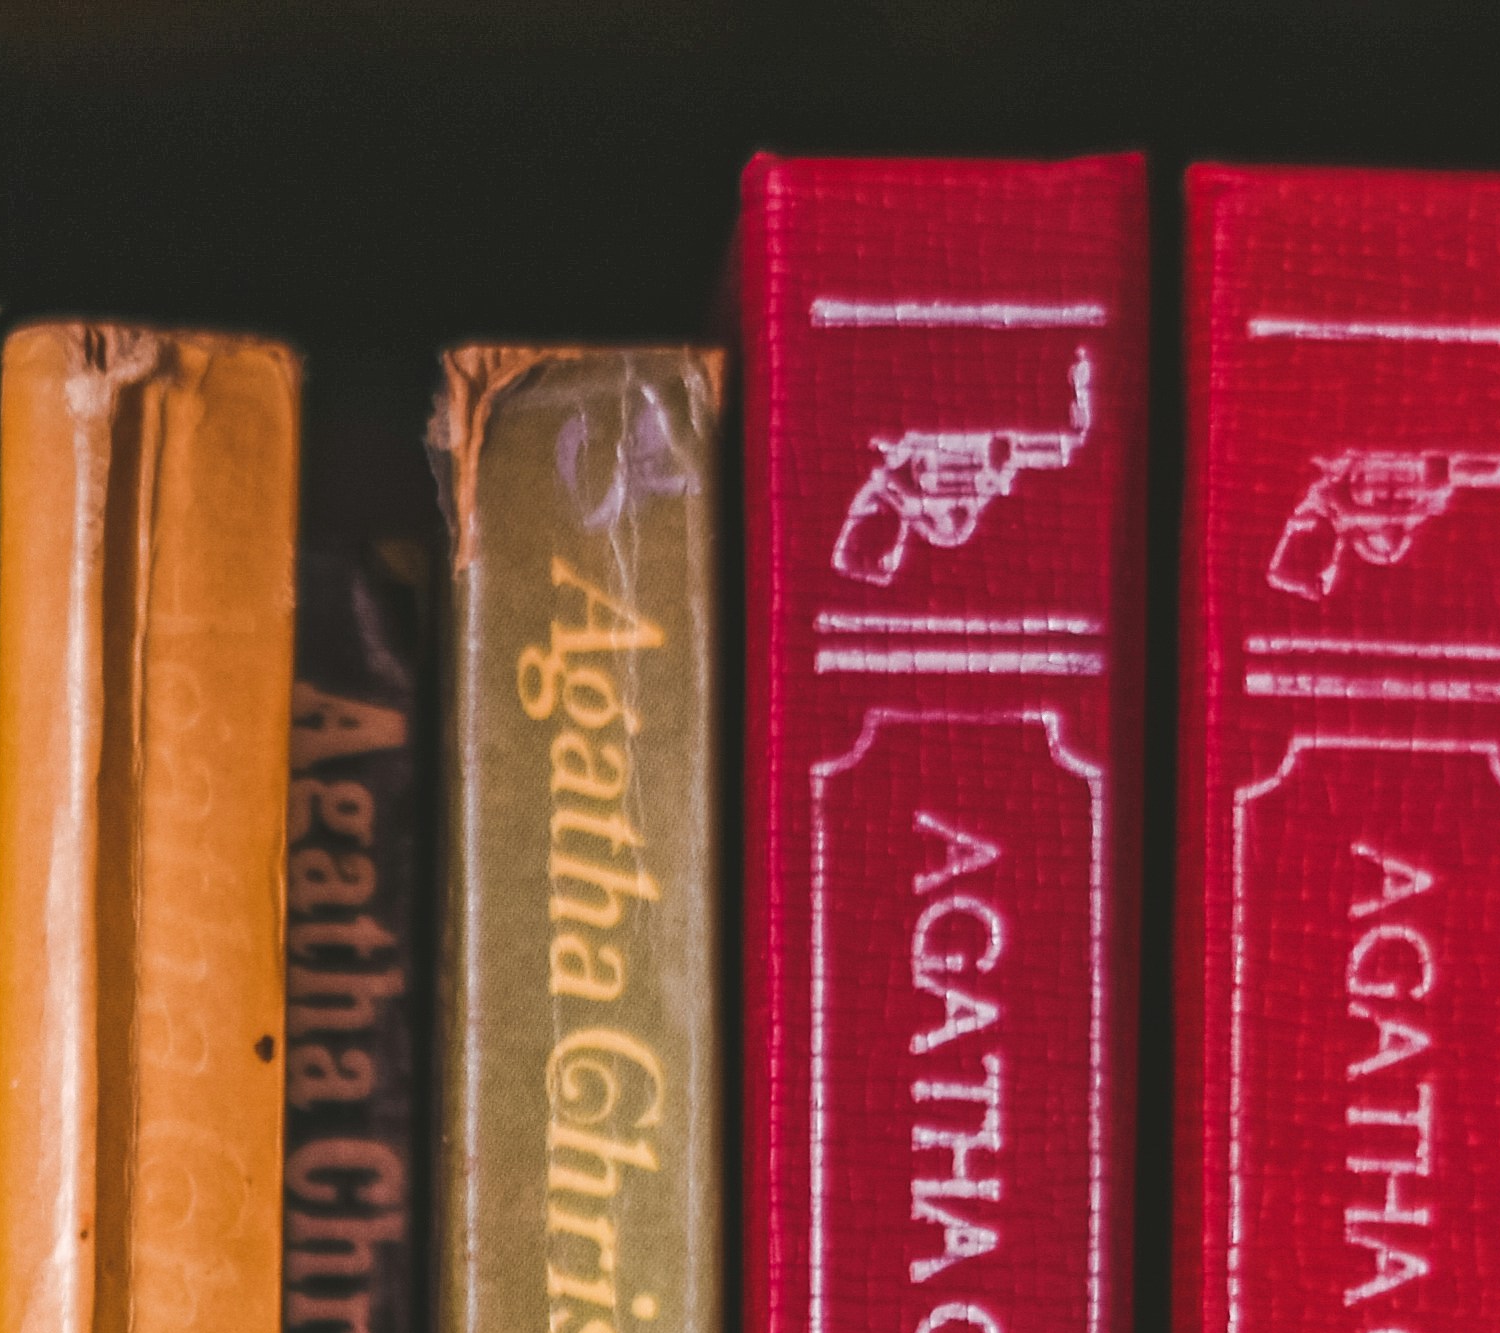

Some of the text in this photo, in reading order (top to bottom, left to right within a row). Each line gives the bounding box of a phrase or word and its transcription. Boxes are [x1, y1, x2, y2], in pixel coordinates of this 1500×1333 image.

[287, 680, 409, 1106] Agatha
[516, 556, 668, 1003] Agatha
[910, 810, 1002, 1284] AGATHA
[1342, 840, 1433, 1306] AGATHA
